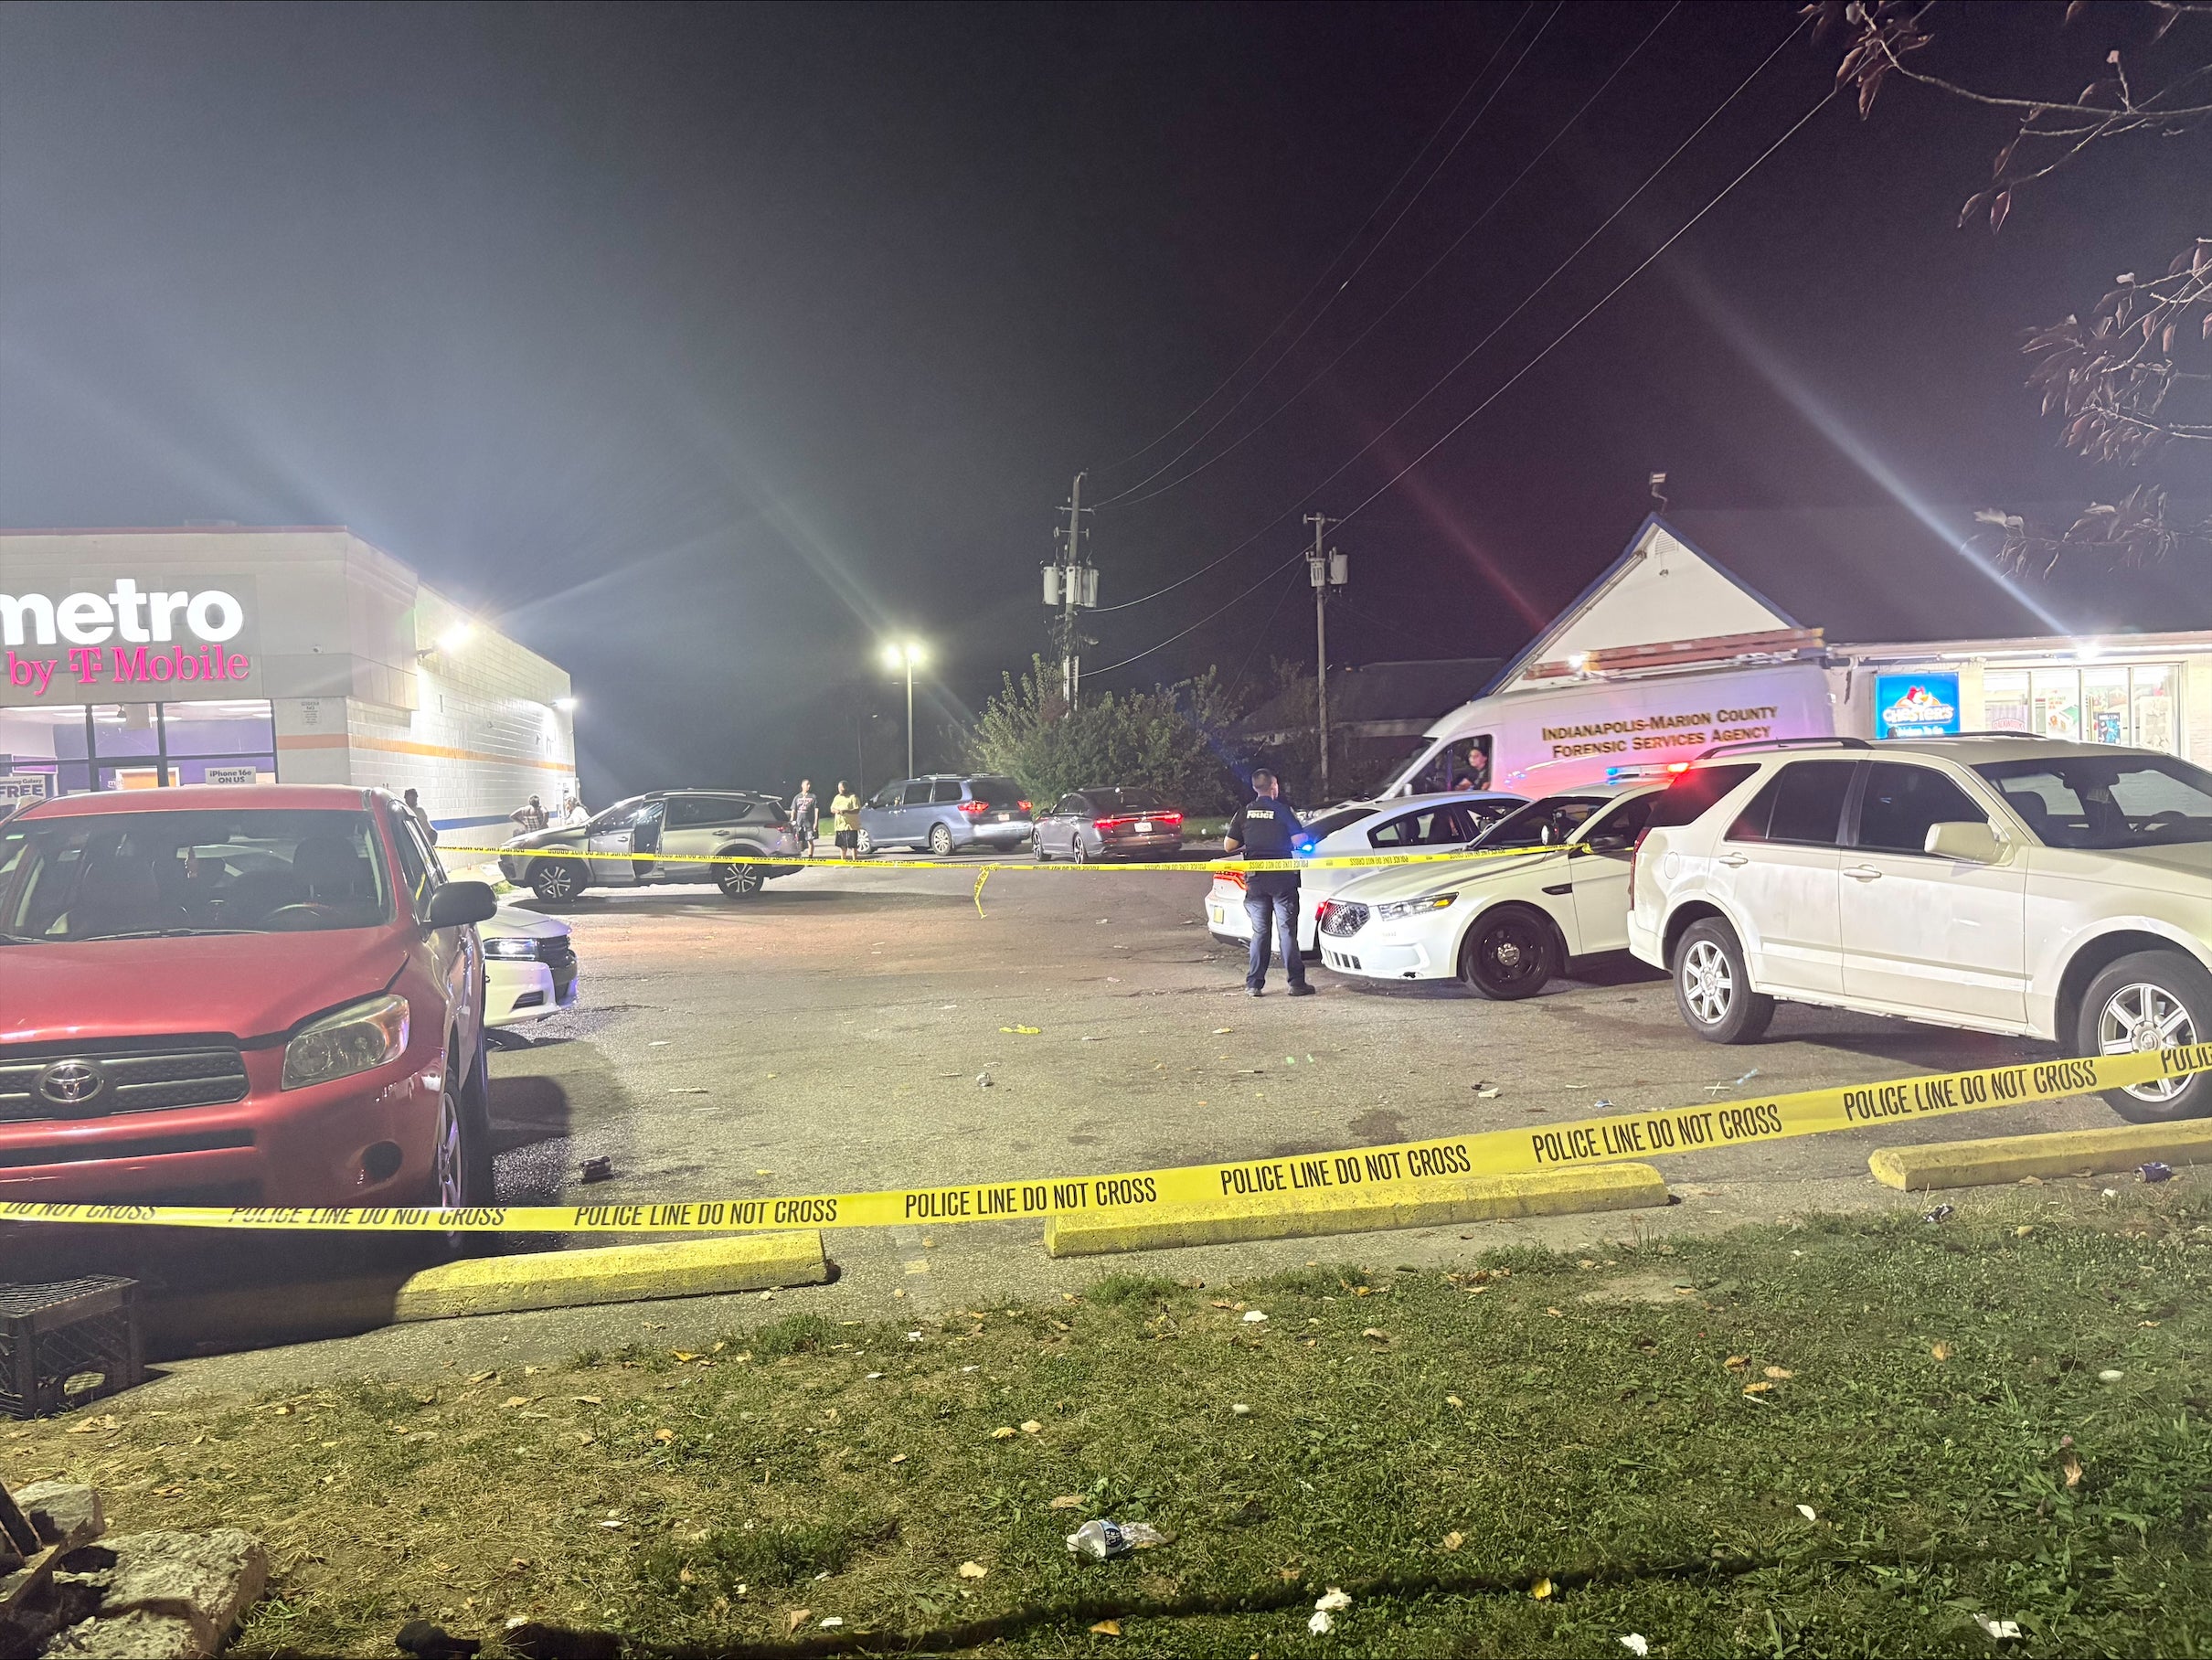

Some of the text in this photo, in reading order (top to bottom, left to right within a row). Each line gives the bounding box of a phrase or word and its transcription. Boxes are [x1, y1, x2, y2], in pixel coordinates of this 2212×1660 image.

[0, 579, 243, 645] metro
[6, 651, 58, 696] by
[111, 644, 249, 682] Mobile
[1553, 726, 1771, 758] FORENSIC SERVICES AGENCY
[0, 784, 44, 798] FREE
[1246, 811, 1275, 819] POLICE
[1844, 1059, 2097, 1121] POLICE LINE DO NOT CROSS
[1532, 1104, 1782, 1163] POLICE LINE DO NOT CROSS
[1220, 1144, 1471, 1195] POLICE LINE DO NOT CROSS
[574, 1199, 837, 1226] POLICE LINE DO NOT CROSS
[905, 1177, 1157, 1218] POLICE LINE DO NOT CROSS
